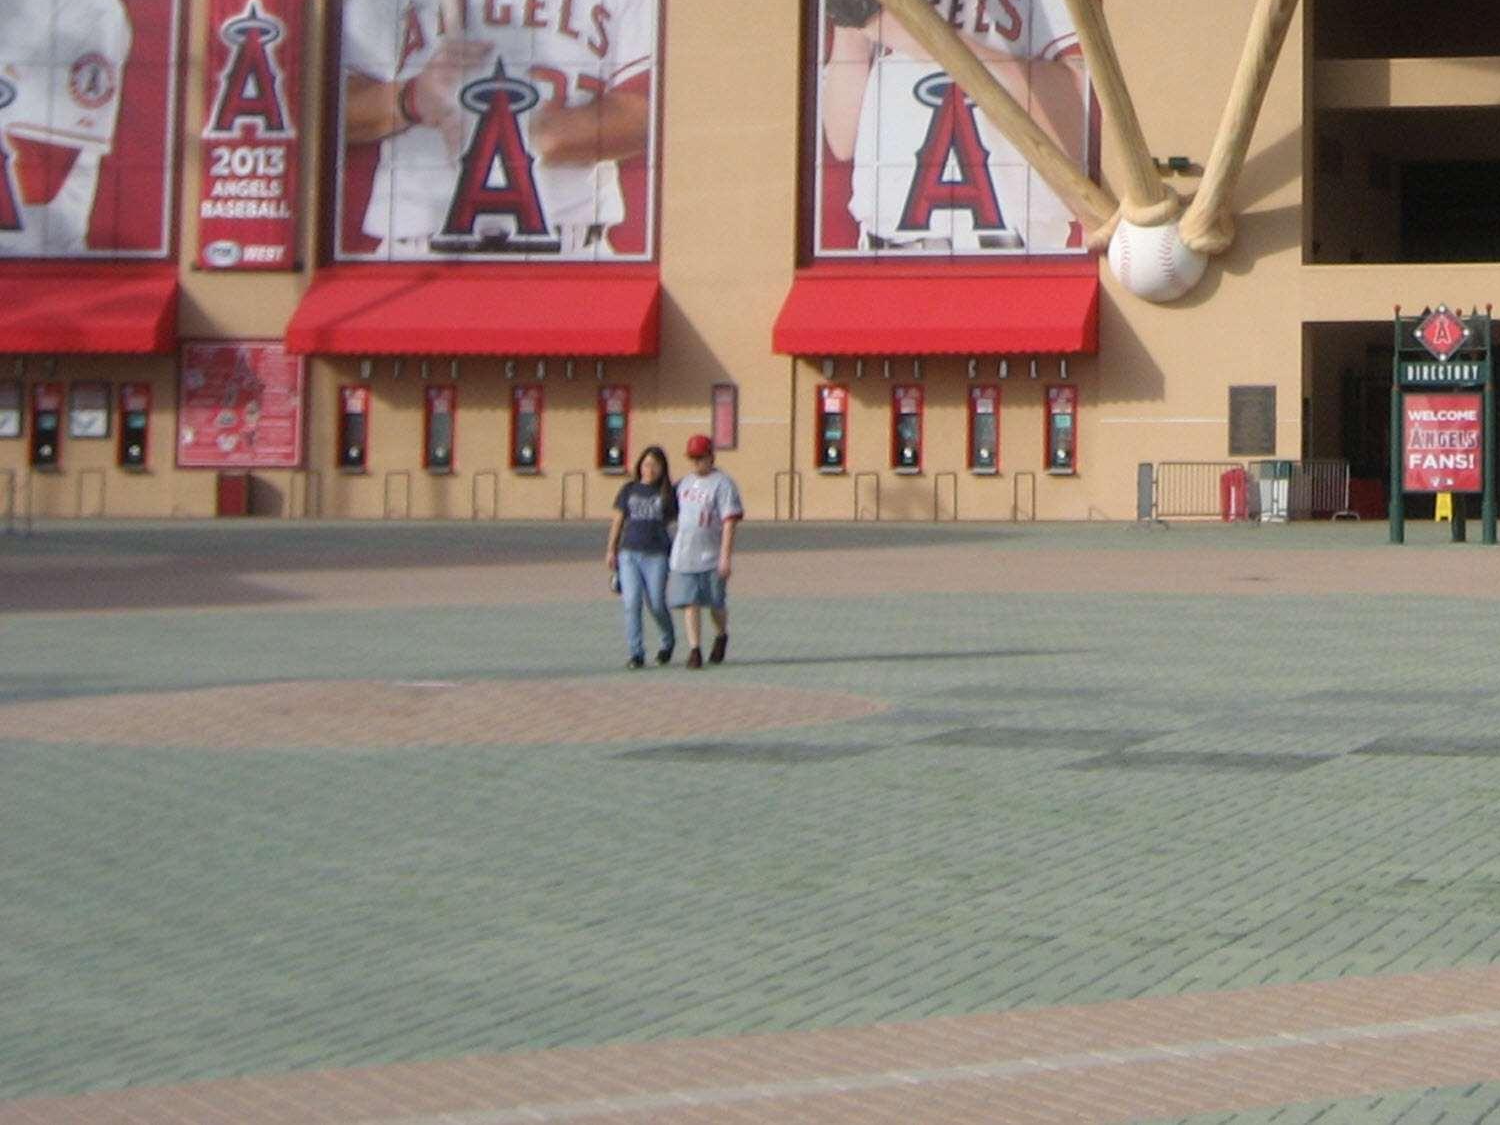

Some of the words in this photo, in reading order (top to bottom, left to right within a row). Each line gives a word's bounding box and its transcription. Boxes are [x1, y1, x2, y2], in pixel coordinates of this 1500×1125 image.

[209, 145, 286, 176] 2013
[210, 178, 283, 198] ANGELS
[201, 200, 290, 219] BASEBALL
[1407, 365, 1479, 381] DIRECTORY
[1408, 410, 1477, 421] WELCOME
[1409, 424, 1479, 448] ANGELS
[1409, 454, 1475, 469] FANS!
